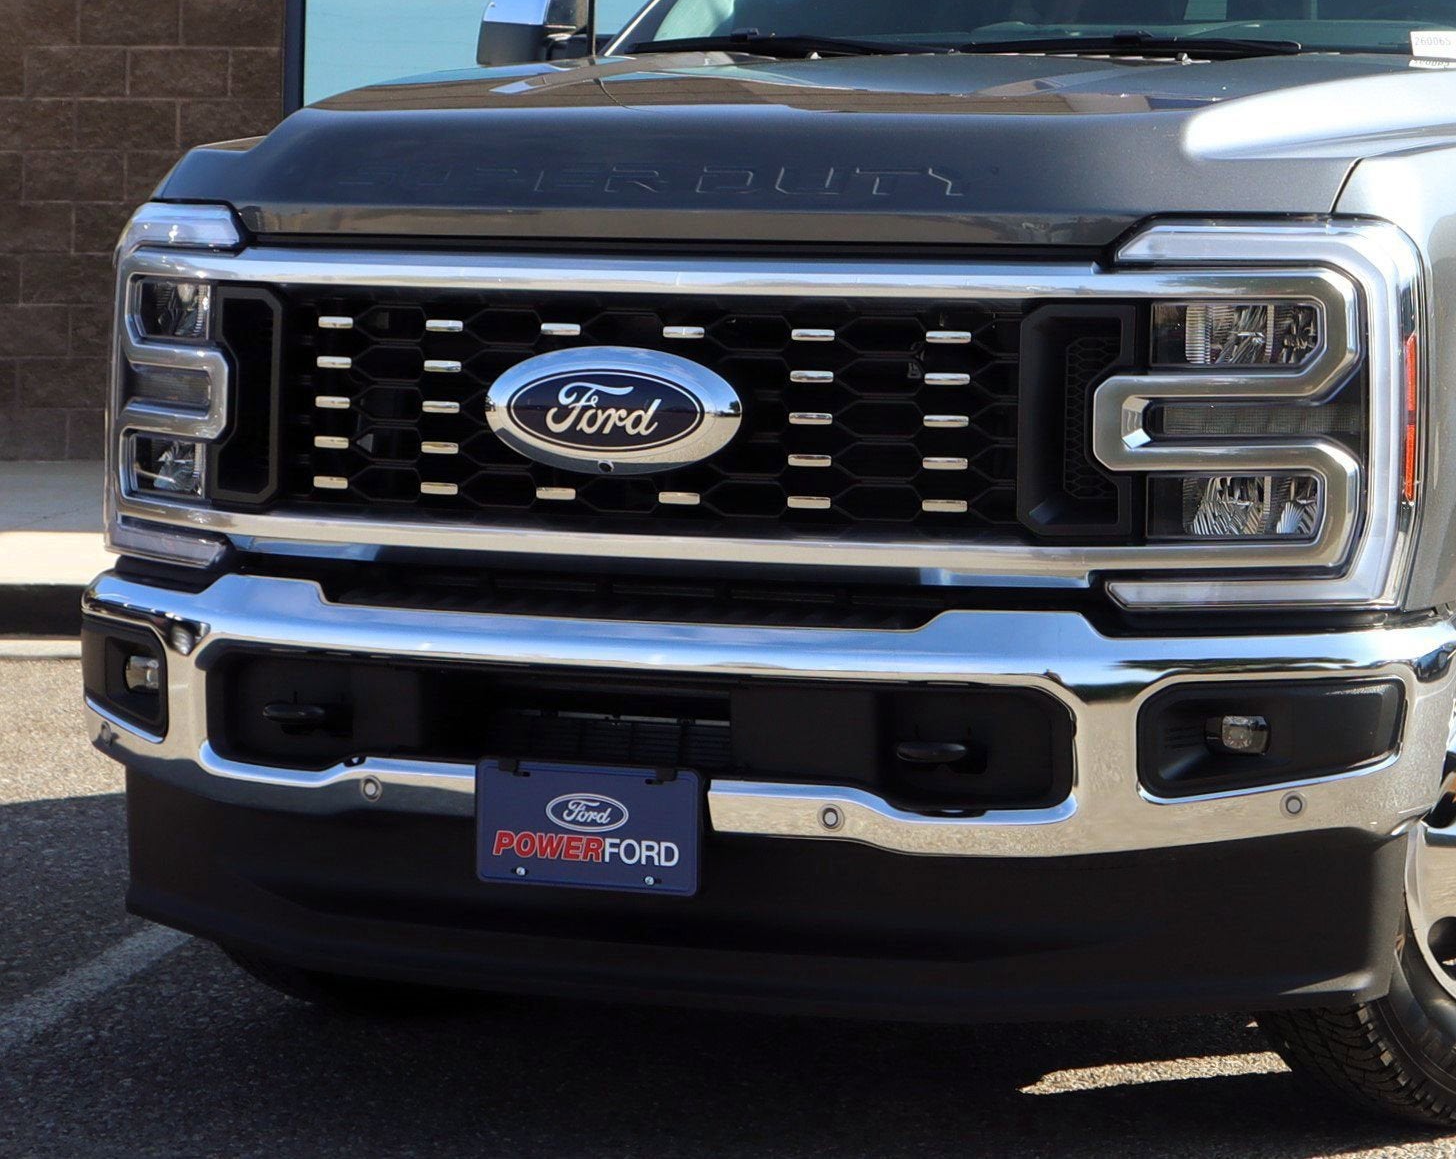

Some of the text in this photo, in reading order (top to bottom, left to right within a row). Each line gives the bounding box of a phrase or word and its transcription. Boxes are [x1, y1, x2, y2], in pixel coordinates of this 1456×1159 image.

[695, 165, 992, 196] DUTY
[545, 381, 662, 437] Ford
[562, 799, 611, 825] Ford
[493, 831, 679, 866] POWERFORD
